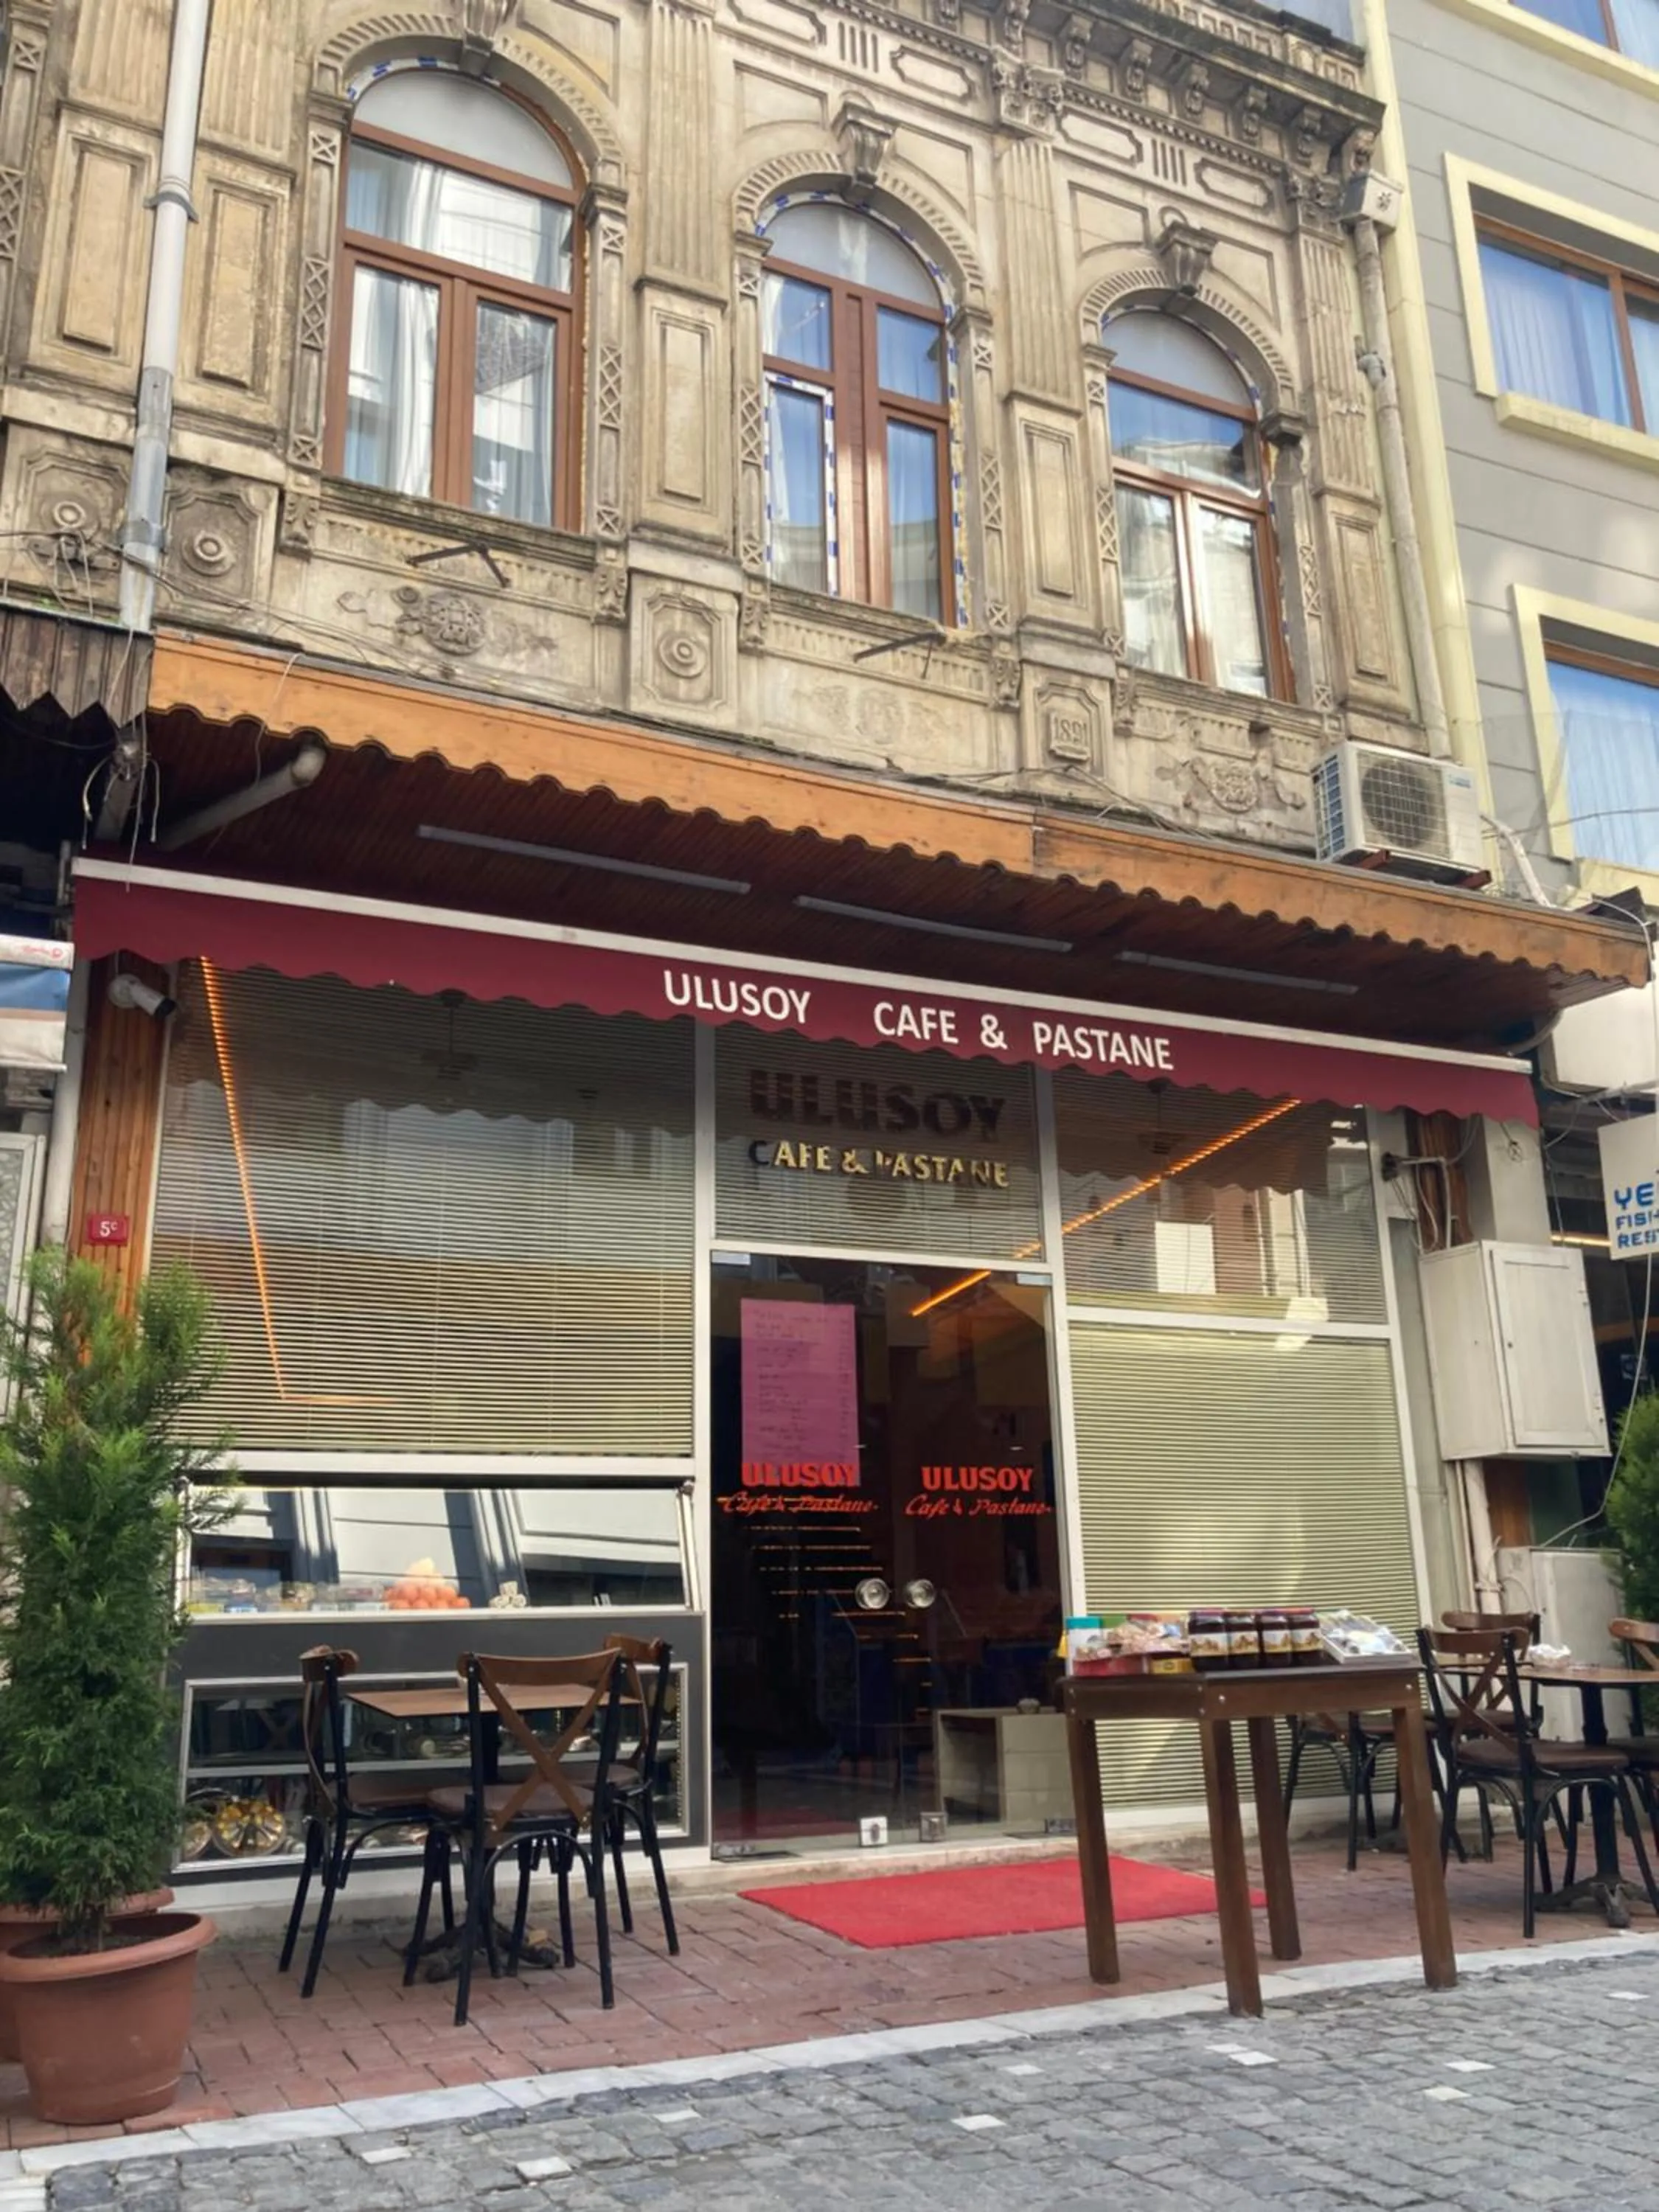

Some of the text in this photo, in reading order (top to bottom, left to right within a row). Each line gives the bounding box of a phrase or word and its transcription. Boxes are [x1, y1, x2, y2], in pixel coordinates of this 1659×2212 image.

[664, 970, 1175, 1071] ULUSOY CAFE & PASTANE
[750, 1070, 1006, 1140] ULUSOY
[748, 1140, 832, 1171] CAFE
[841, 1148, 869, 1175] &
[1614, 1181, 1659, 1210] YE
[742, 1462, 857, 1486] ULUSOY
[921, 1467, 1033, 1491] ULUSOY
[905, 1495, 949, 1520] Cafe
[968, 1498, 1052, 1517] Pastane
